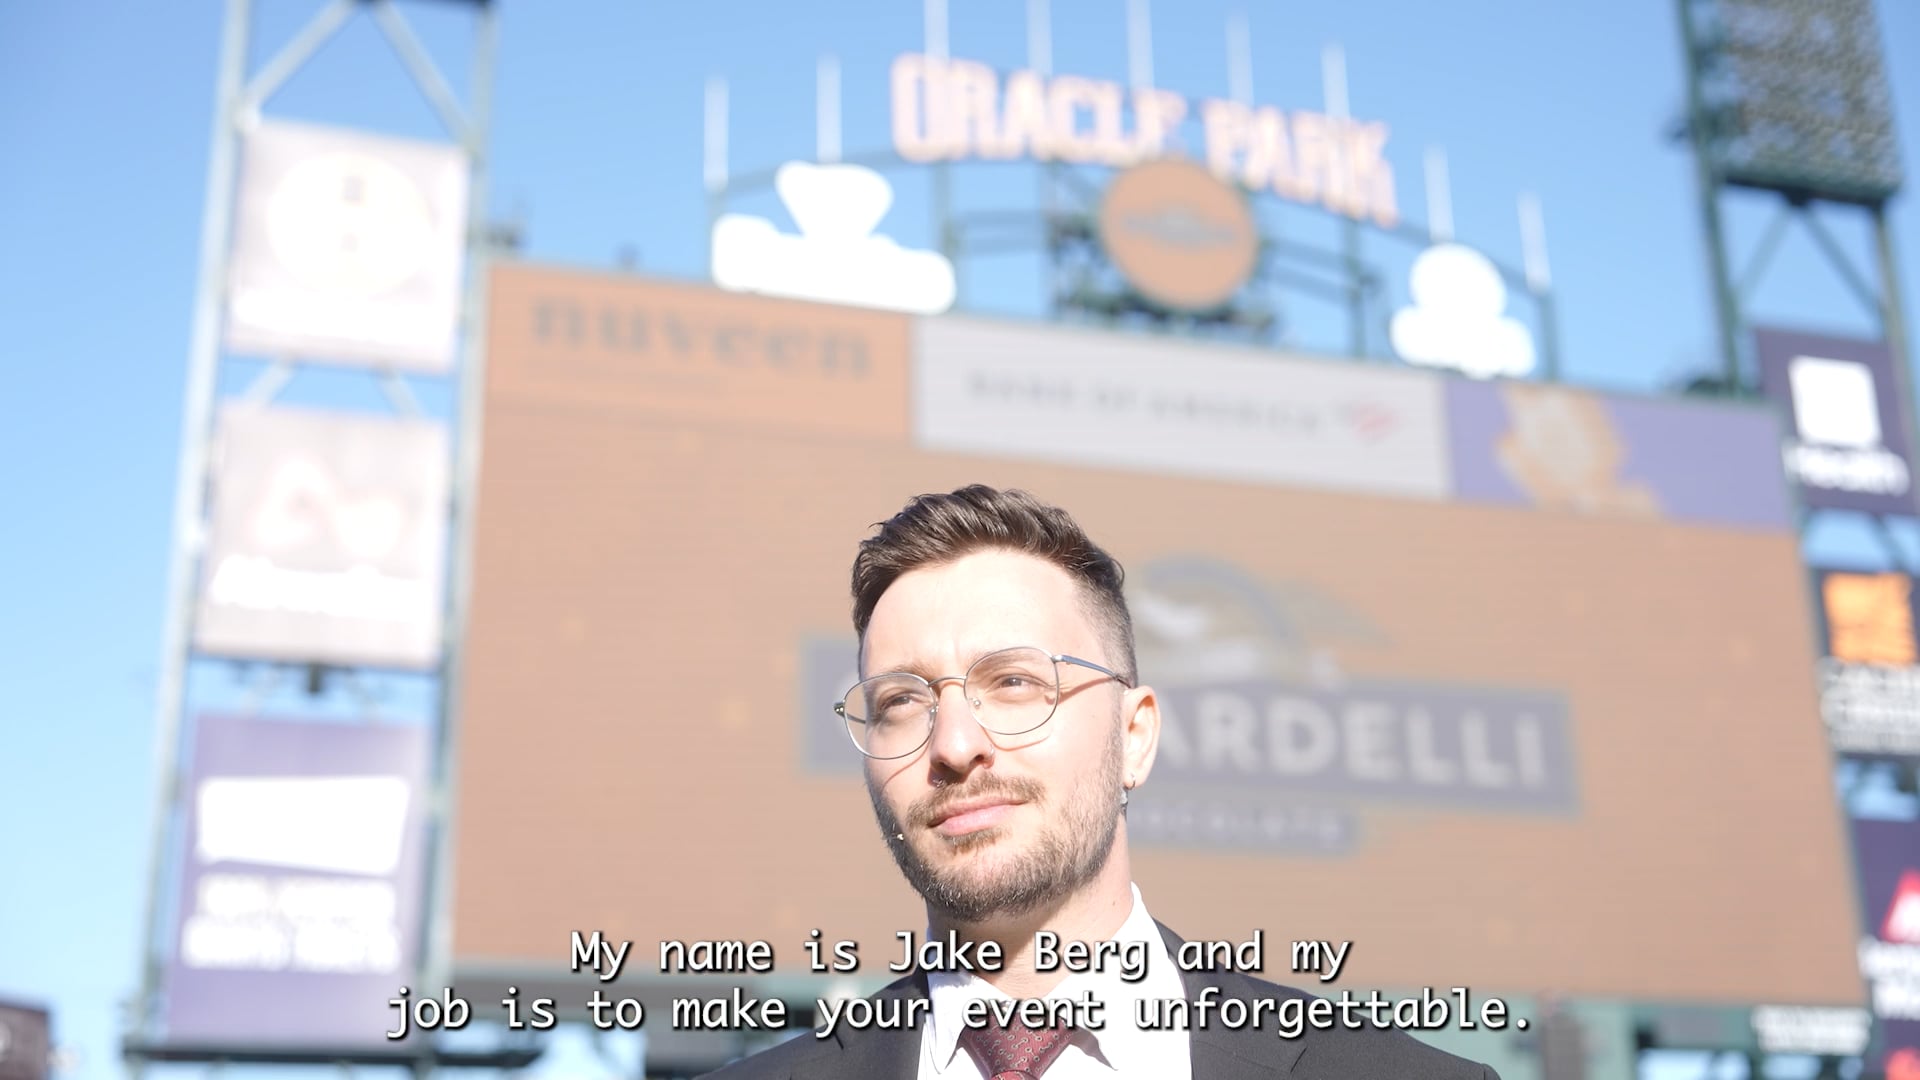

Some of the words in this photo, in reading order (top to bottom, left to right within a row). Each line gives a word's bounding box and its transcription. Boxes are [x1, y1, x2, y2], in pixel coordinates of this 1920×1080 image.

[890, 52, 1187, 166] ORACLE
[1203, 97, 1398, 228] PARK
[531, 296, 872, 379] nuveen
